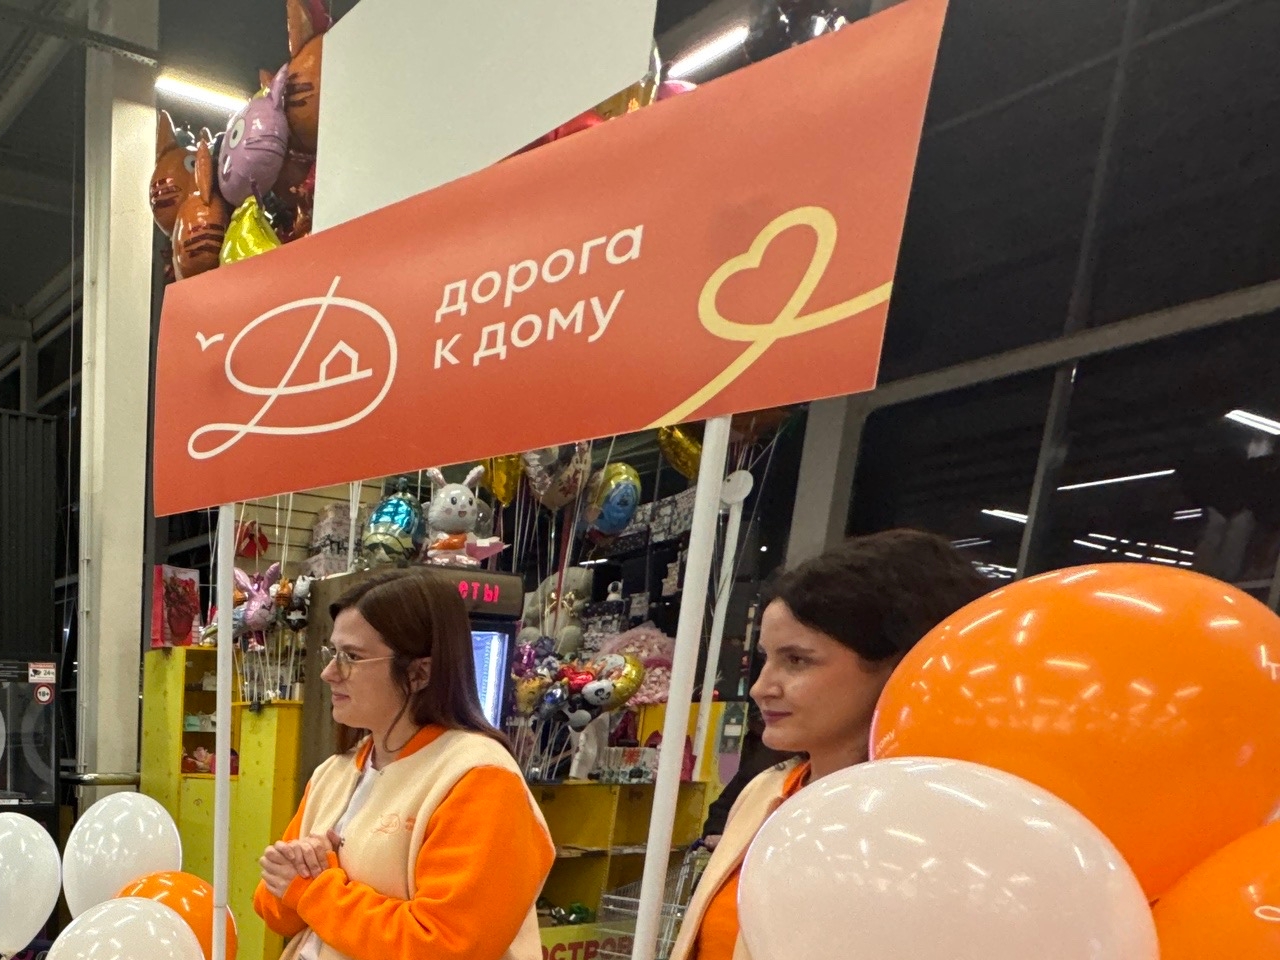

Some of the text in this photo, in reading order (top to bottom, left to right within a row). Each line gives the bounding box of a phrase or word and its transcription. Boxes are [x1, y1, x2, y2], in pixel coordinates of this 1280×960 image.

[434, 224, 645, 323] дорога
[433, 290, 625, 369] к дому
